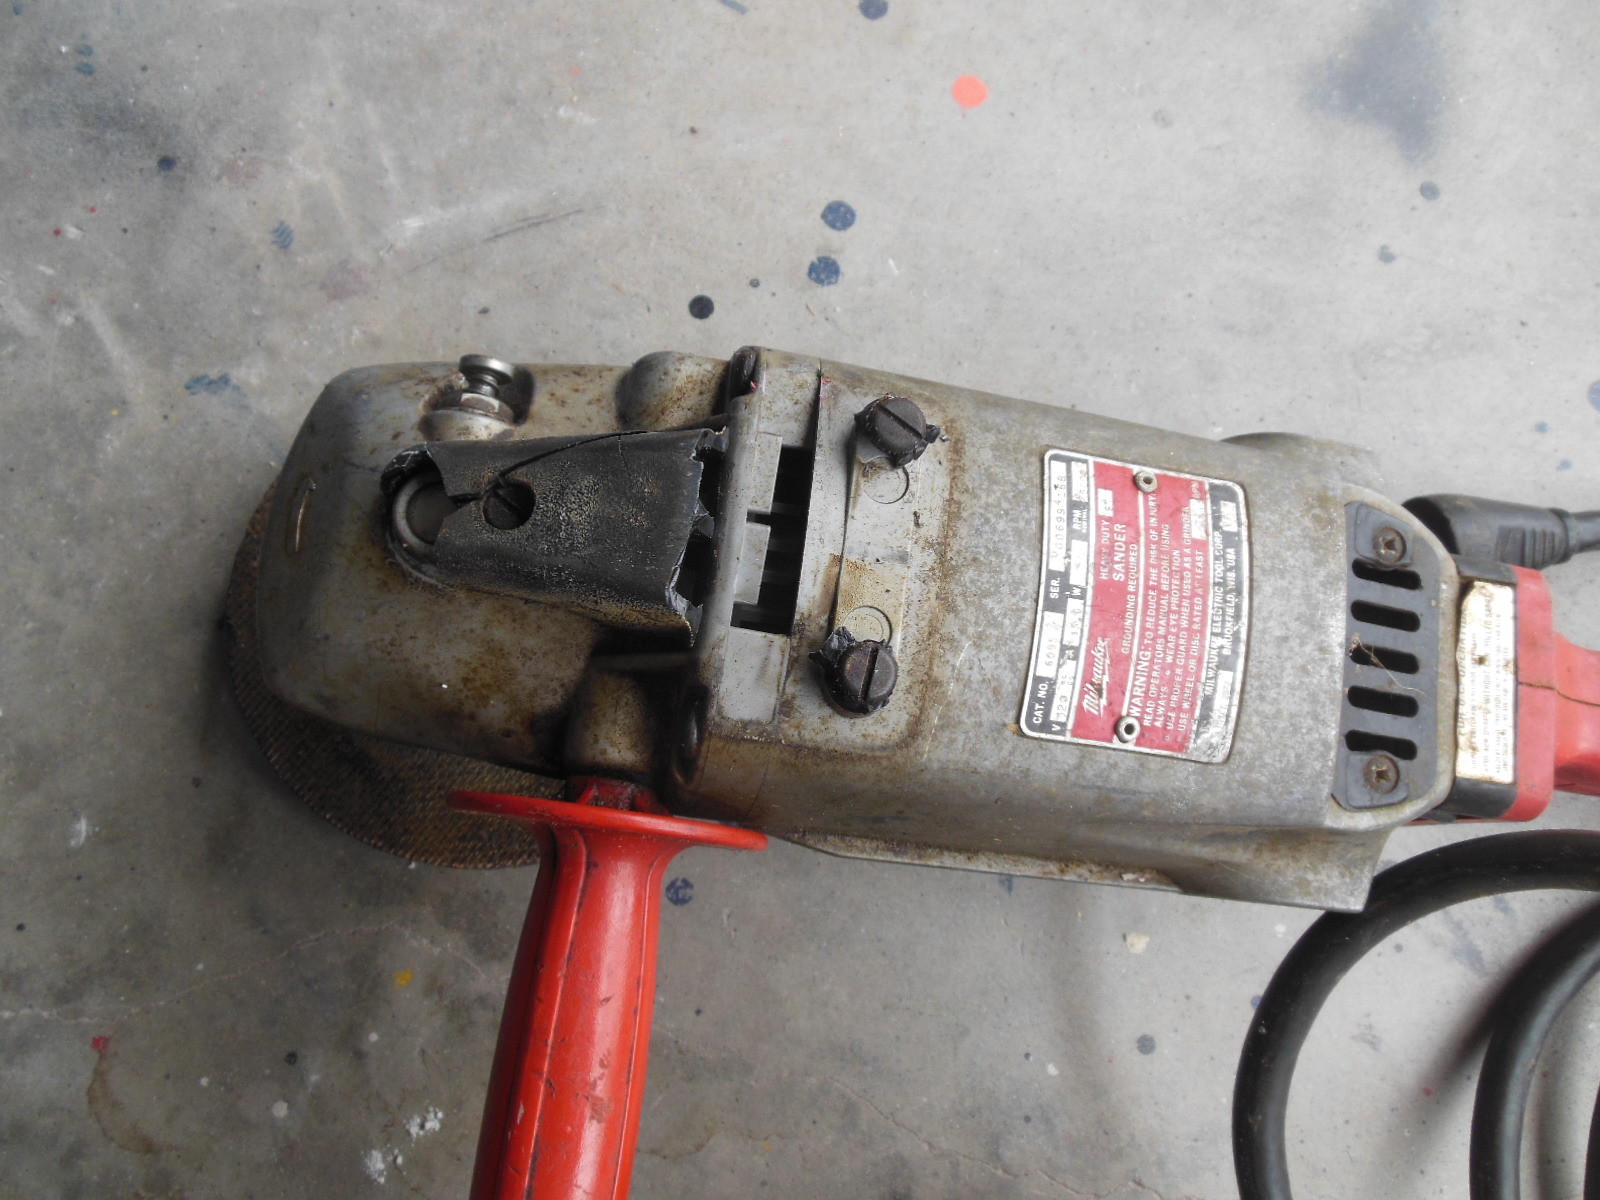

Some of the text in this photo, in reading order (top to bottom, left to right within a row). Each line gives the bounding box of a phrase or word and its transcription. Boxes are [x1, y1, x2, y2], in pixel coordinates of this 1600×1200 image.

[1072, 510, 1082, 529] RPM
[1101, 520, 1110, 544] DUTY
[1182, 506, 1191, 544] GRINDER
[1150, 530, 1158, 540] OF
[1100, 548, 1109, 579] HEAVY
[1113, 524, 1126, 581] SANDER
[1183, 557, 1191, 569] AS
[1227, 548, 1235, 566] USA
[1149, 568, 1157, 585] THE
[1182, 572, 1191, 596] USED
[1215, 560, 1224, 582] TOOL
[1050, 578, 1060, 598] SER.
[1122, 544, 1138, 654] GROUNDING REQUIRED
[1146, 590, 1157, 628] REDUCE
[1181, 600, 1190, 628] WHEN
[1212, 585, 1223, 632] ELECTRIC
[1143, 524, 1169, 726] READ OPERATORS MANUAL BEFORE USING
[1144, 632, 1153, 644] TO
[1154, 550, 1180, 727] ALWAYS WEAR EYE PROTECTION
[1177, 631, 1187, 665] GUARD
[1178, 550, 1204, 730] USE WHEEL OR DISC RATED AT LEAST
[1205, 636, 1220, 695] MILWAUKEE
[1038, 681, 1049, 698] NO.
[1129, 647, 1152, 717] WARNING:
[1170, 668, 1183, 707] PROPER
[1033, 702, 1045, 724] CAT.
[1166, 712, 1176, 729] USE
